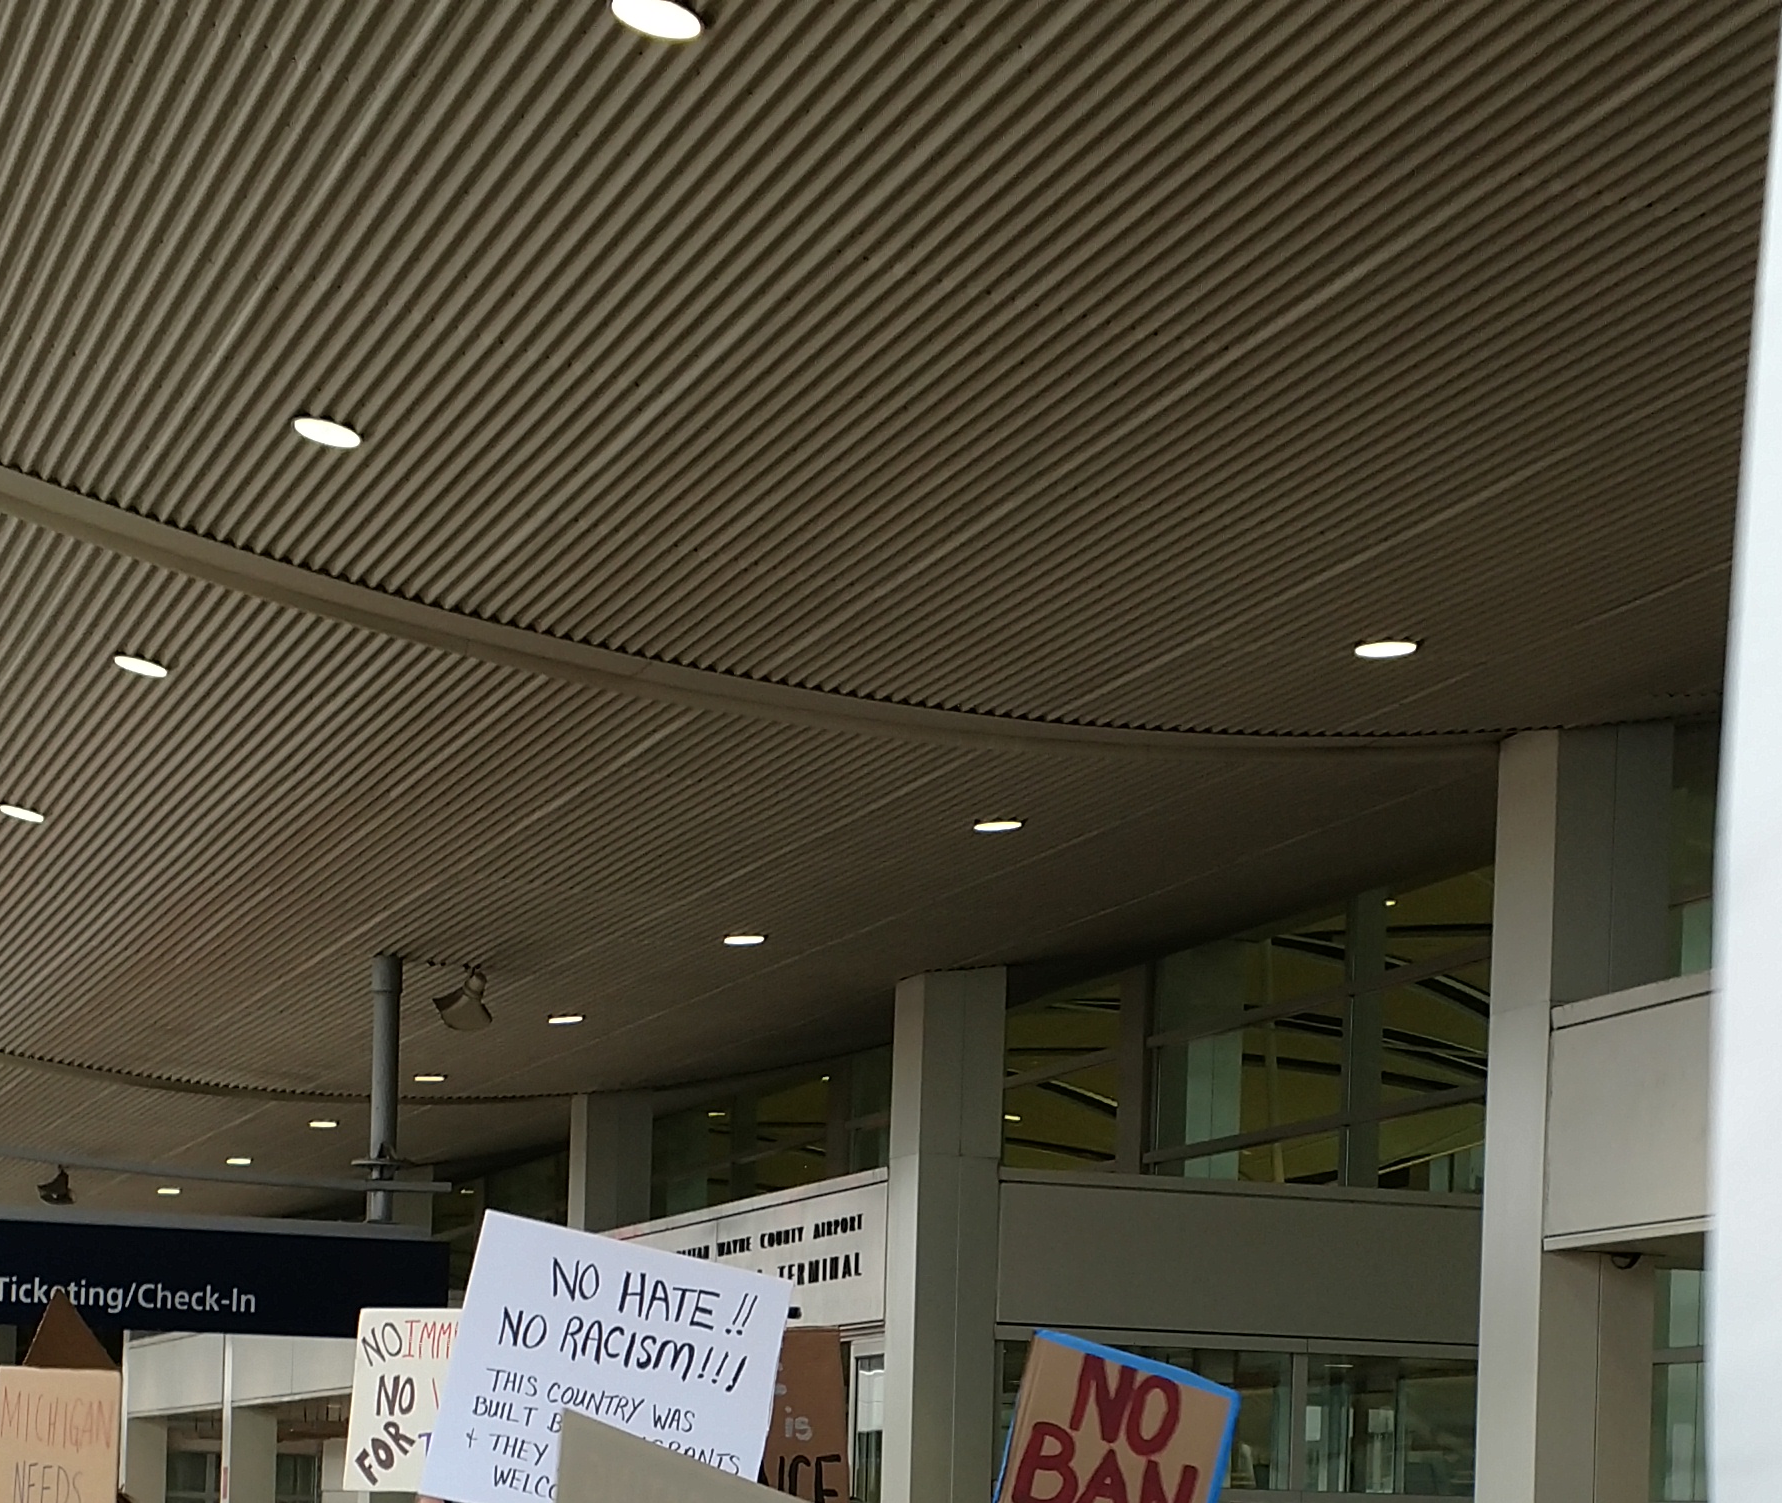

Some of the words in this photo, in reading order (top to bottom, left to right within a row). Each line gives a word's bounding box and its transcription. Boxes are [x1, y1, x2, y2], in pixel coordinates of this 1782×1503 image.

[717, 1237, 752, 1257] WAYNE
[760, 1227, 804, 1249] COUNTY
[813, 1213, 864, 1240] AIRPORT
[777, 1252, 863, 1286] TERMINAL
[552, 1257, 600, 1302] NO
[618, 1271, 720, 1331] HATE
[361, 1322, 403, 1367] NO
[402, 1320, 459, 1359] IMM
[498, 1306, 547, 1349] NO
[376, 1374, 415, 1417] NO
[473, 1396, 538, 1427] BUILT
[486, 1368, 538, 1397] THIS
[547, 1382, 645, 1423] COUNTRY
[653, 1404, 696, 1434] WAS
[1070, 1353, 1182, 1456] NO
[1, 1386, 113, 1453] MICHIGAN
[785, 1406, 813, 1441] is
[355, 1421, 416, 1486] FOR
[489, 1433, 549, 1467] THEY
